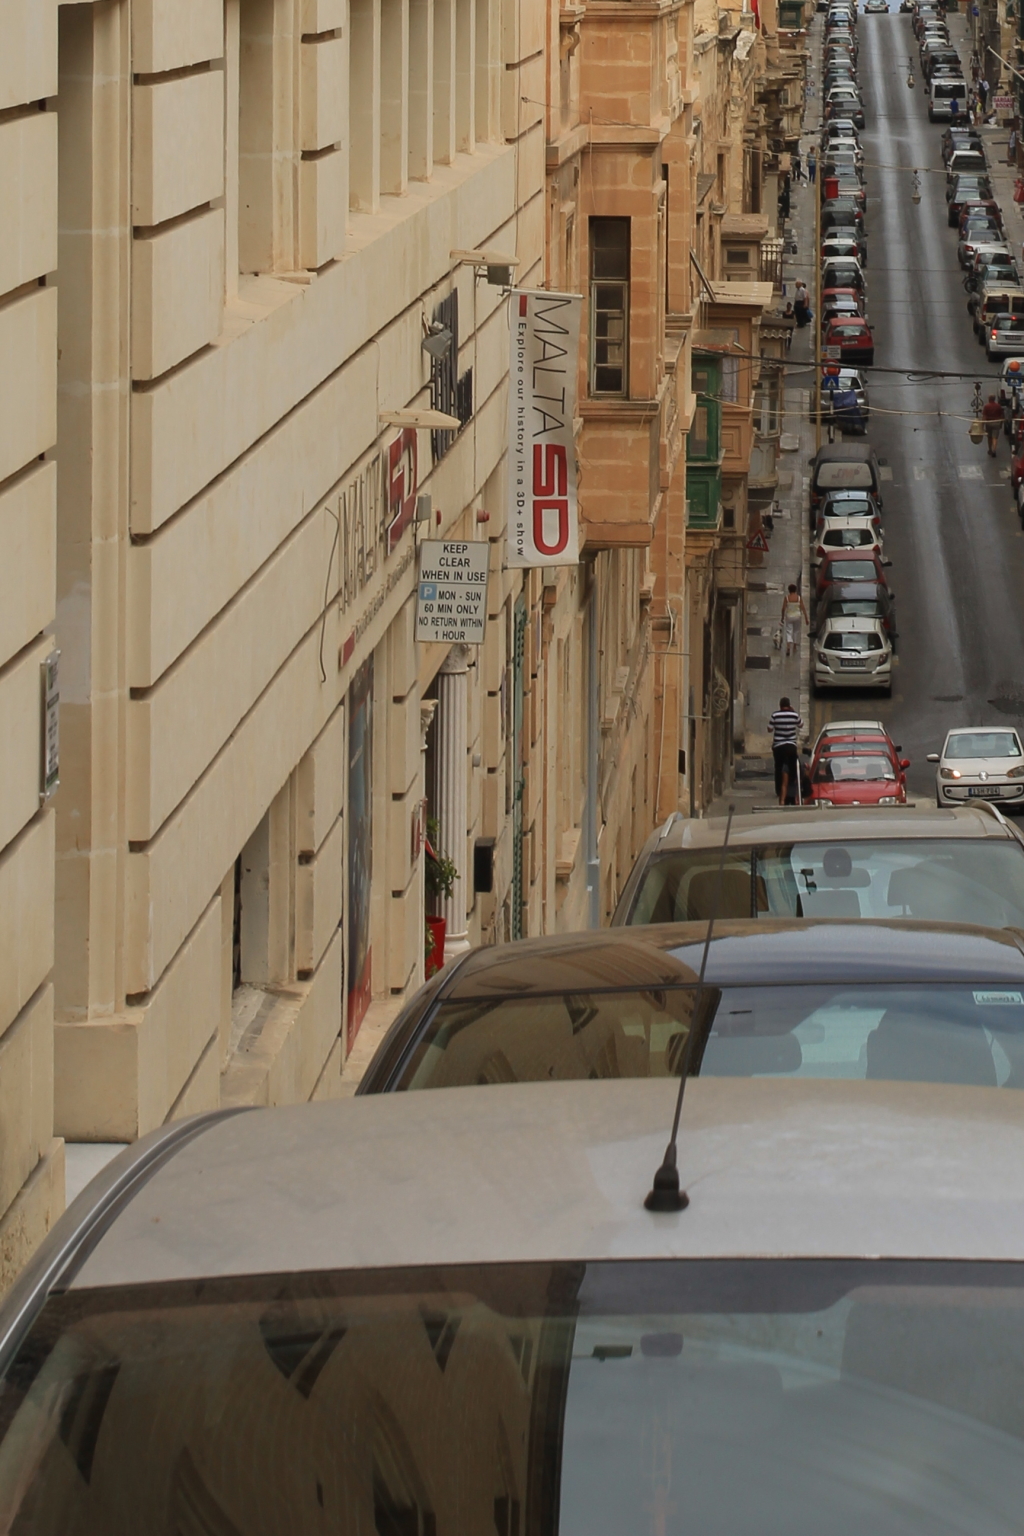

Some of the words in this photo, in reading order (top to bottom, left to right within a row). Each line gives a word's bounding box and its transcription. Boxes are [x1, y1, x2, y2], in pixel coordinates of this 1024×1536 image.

[514, 322, 525, 373] Explore
[531, 297, 571, 437] MALTA
[515, 407, 524, 454] history
[516, 460, 524, 472] in
[515, 491, 524, 516] 3D+
[515, 522, 524, 557] show
[443, 544, 468, 554] KEEP
[439, 557, 471, 567] CLEAR
[422, 570, 450, 580] WHEN
[454, 571, 463, 581] IN
[467, 572, 486, 582] USE
[438, 590, 456, 600] MON
[465, 591, 481, 601] SUN
[424, 603, 434, 613] 60
[437, 604, 453, 614] MIN
[456, 604, 479, 615] ONLY
[418, 616, 429, 626] NO
[431, 617, 458, 627] RETURN
[460, 618, 483, 628] WITHIN
[434, 631, 439, 639] 1
[442, 631, 466, 641] HOUR
